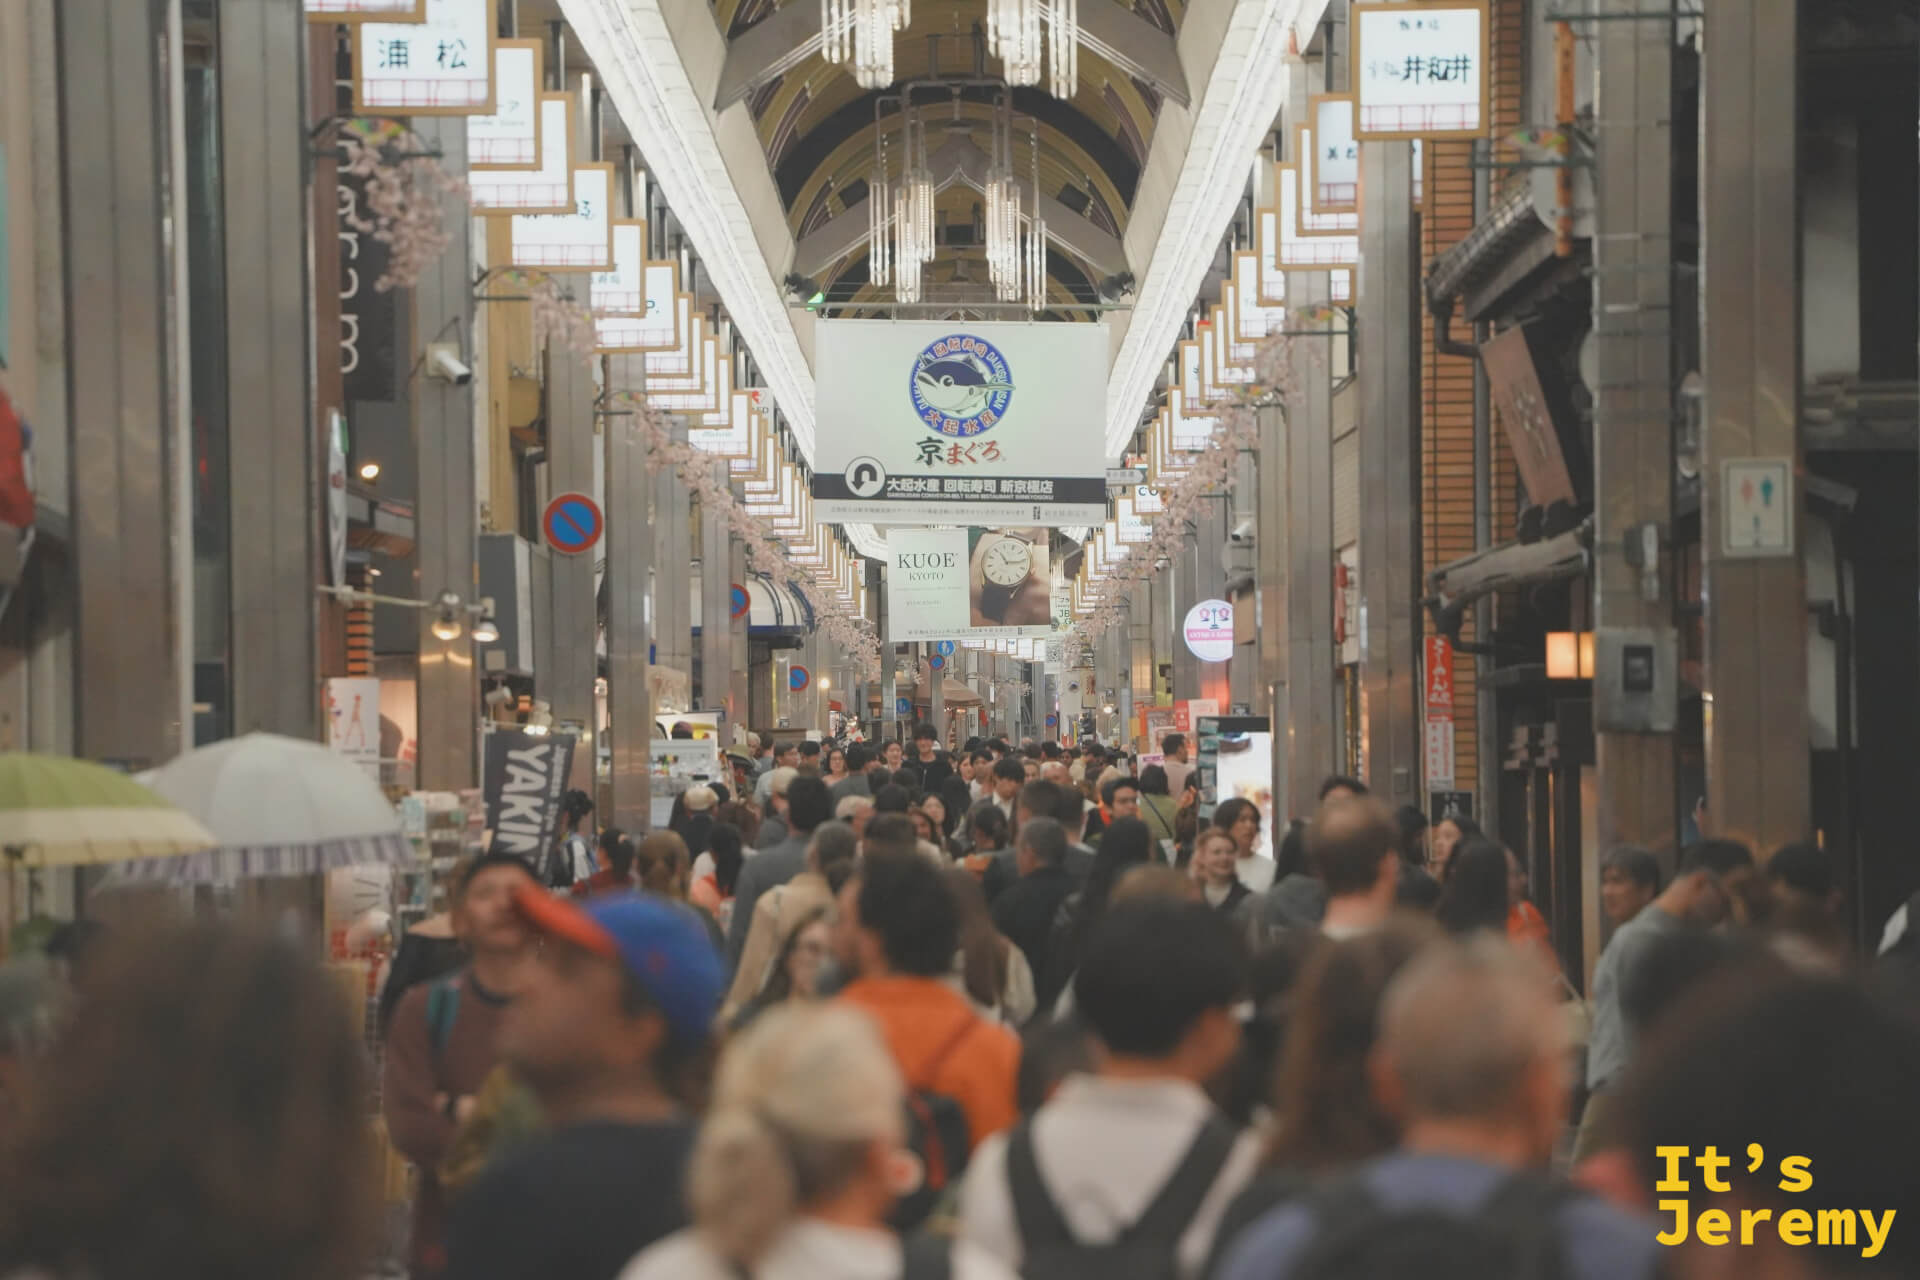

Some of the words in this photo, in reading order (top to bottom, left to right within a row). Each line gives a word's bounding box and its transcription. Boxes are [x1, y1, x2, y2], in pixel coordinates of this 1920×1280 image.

[916, 435, 1001, 466] 京まぐろ
[897, 552, 955, 569] KUOE
[909, 571, 944, 581] KYOTO
[496, 743, 551, 864] YAKIN
